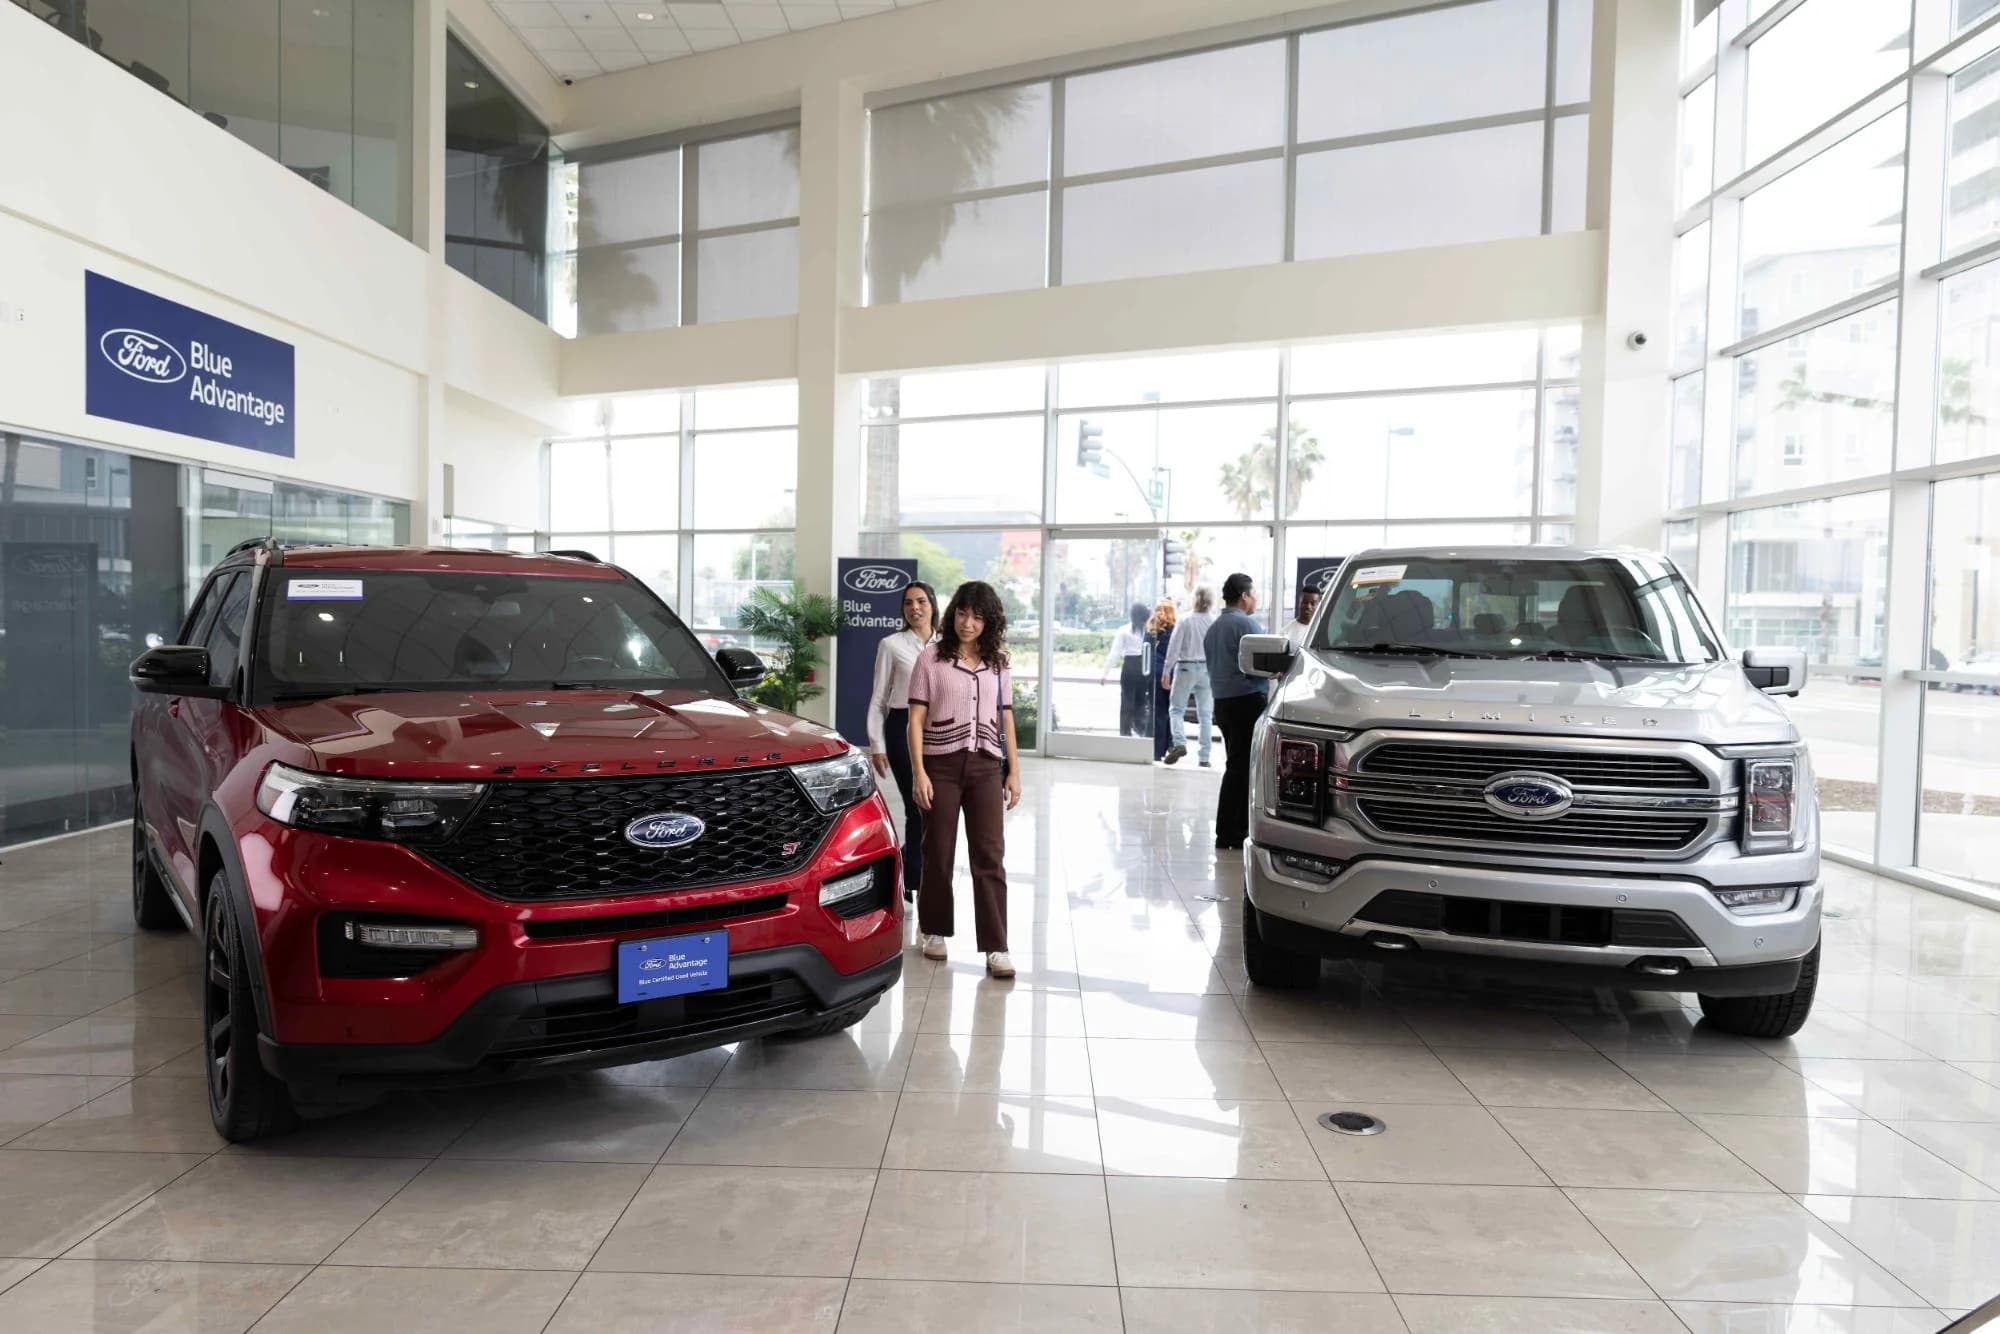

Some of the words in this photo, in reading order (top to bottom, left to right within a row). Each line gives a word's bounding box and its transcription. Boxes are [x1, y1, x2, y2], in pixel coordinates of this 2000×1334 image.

[118, 334, 171, 376] Ford
[190, 341, 232, 378] Blue
[189, 375, 285, 426] Advantage
[855, 569, 899, 589] Ford
[843, 600, 871, 612] Blue
[1408, 706, 1658, 726] LIMITED
[1507, 787, 1549, 805] Ford
[645, 819, 687, 839] Ford
[782, 841, 801, 855] ST
[668, 954, 686, 962] Blue
[668, 959, 708, 969] Advantage
